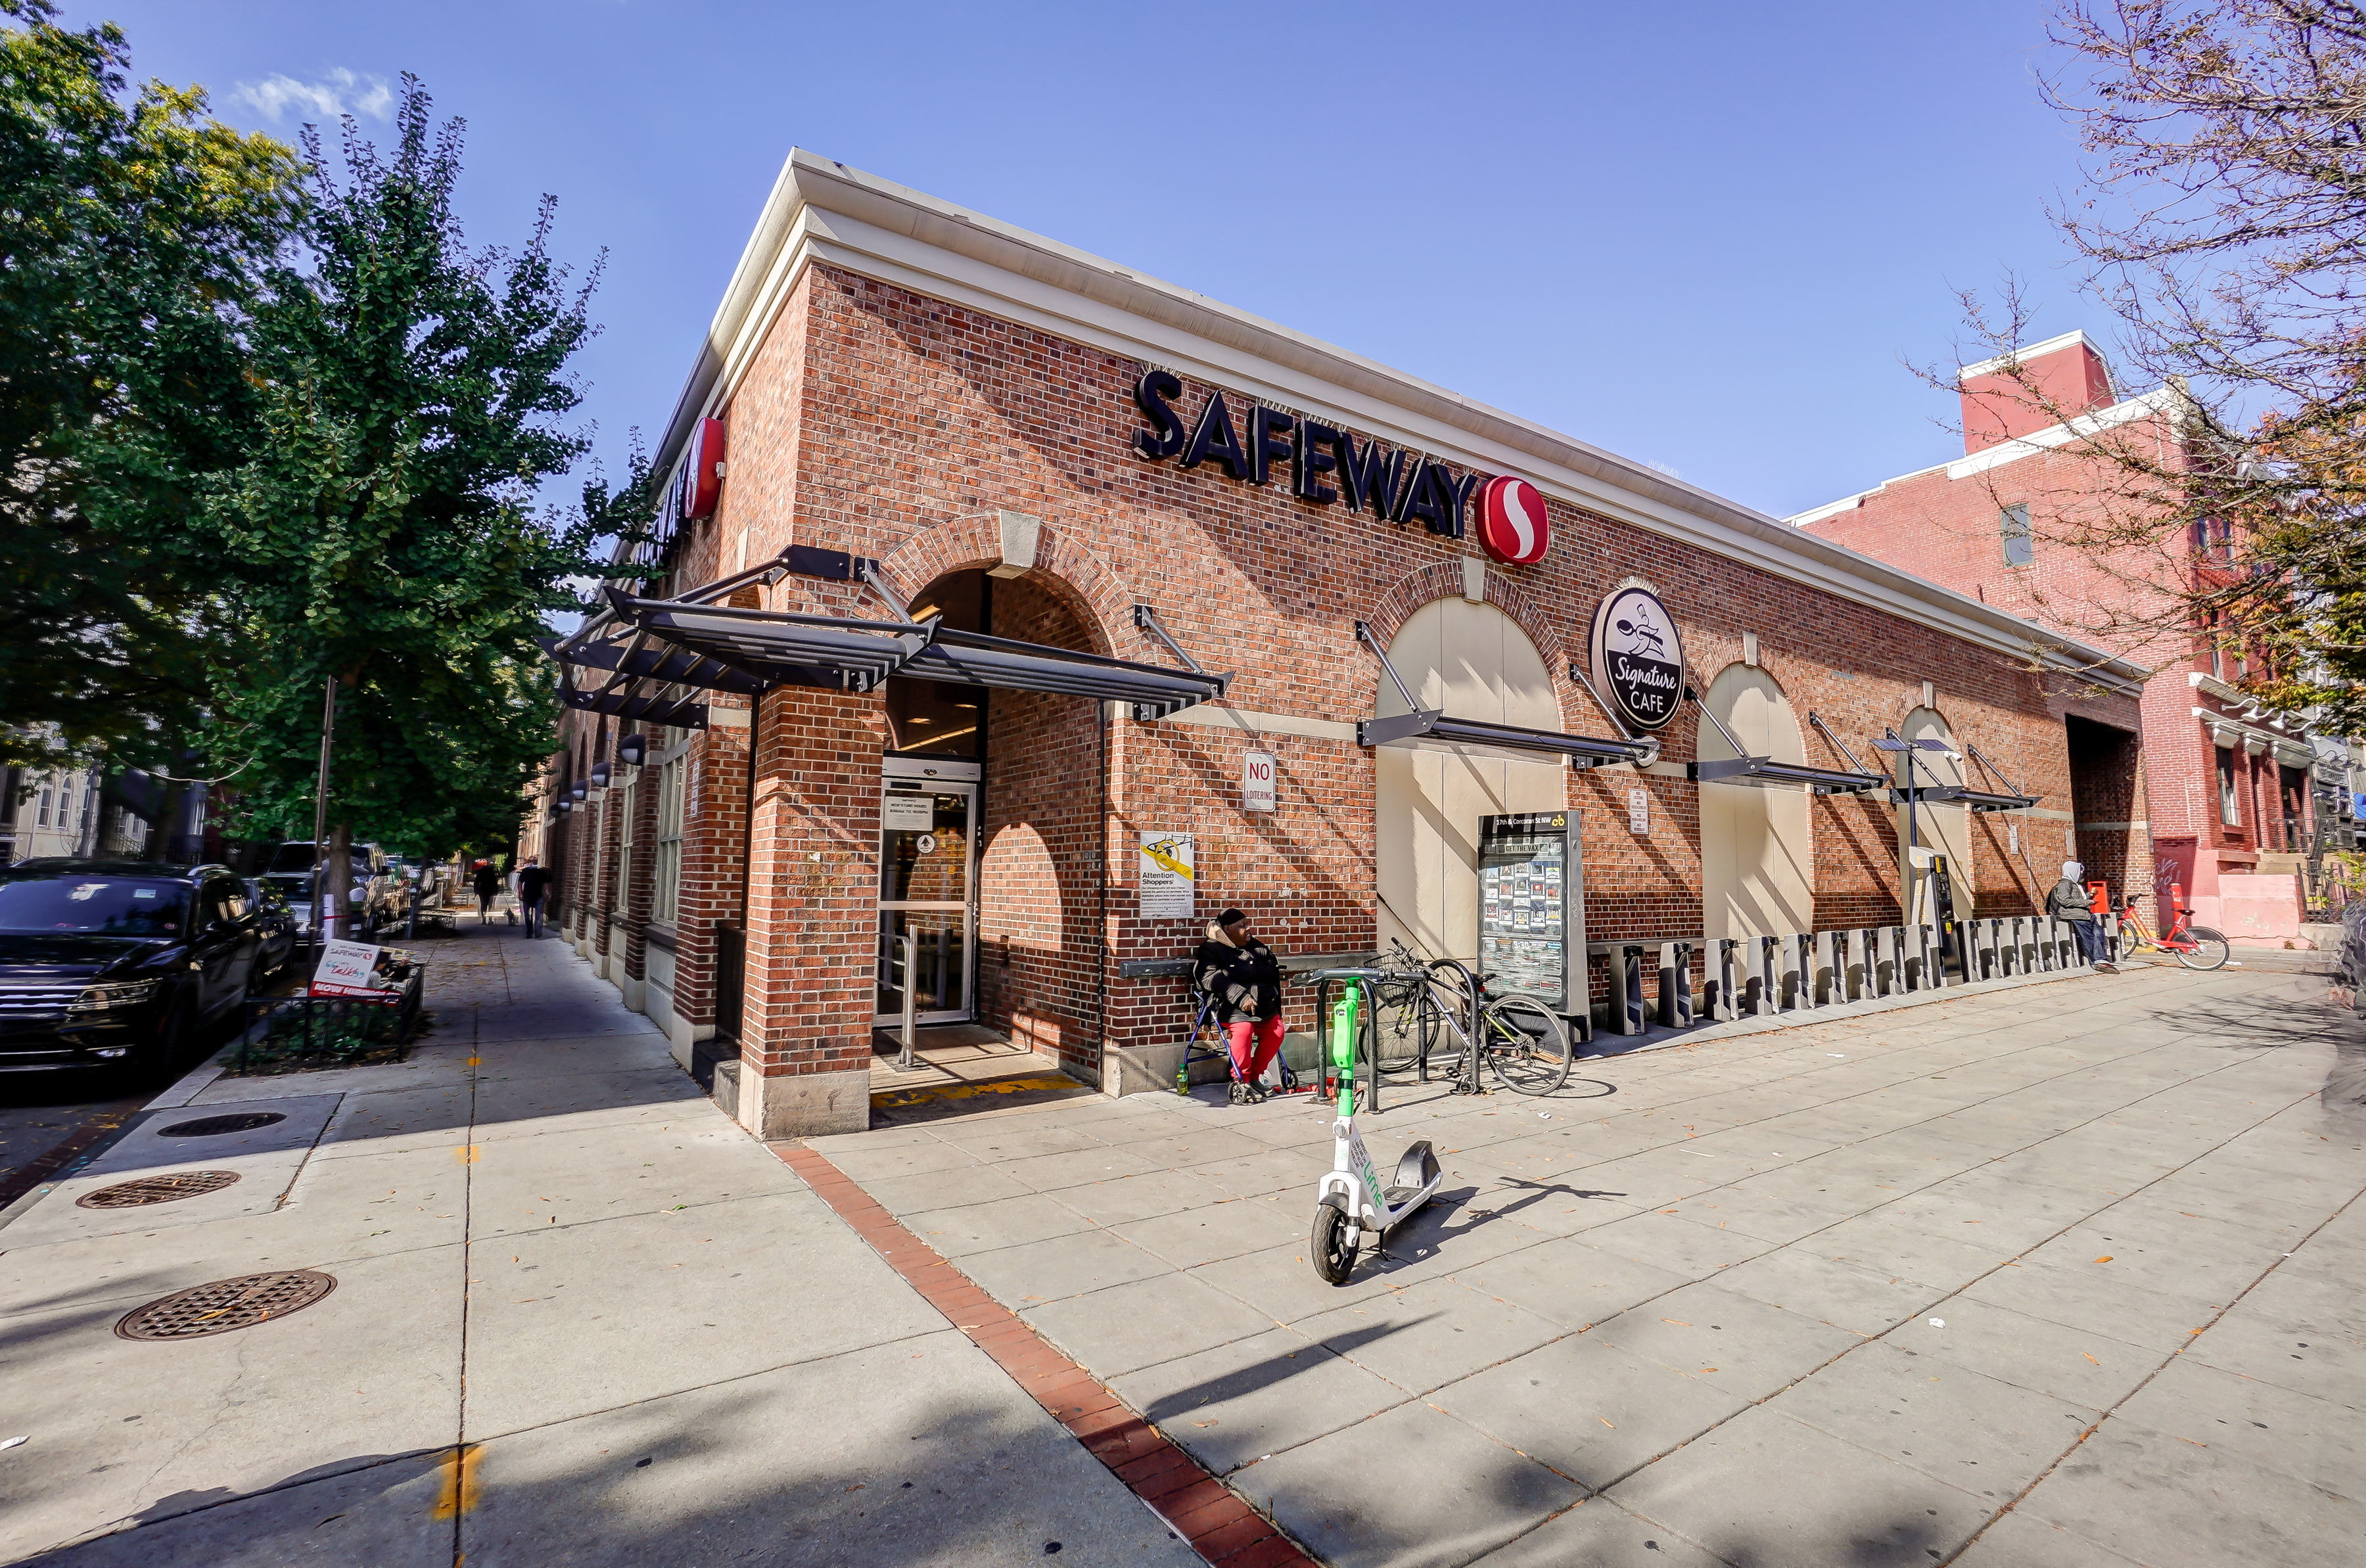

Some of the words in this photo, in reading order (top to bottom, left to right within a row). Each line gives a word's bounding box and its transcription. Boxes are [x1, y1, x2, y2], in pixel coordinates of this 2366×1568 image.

[1132, 369, 1477, 540] SAFEWAY
[1615, 657, 1677, 689] Signature
[1630, 691, 1663, 713] CAFE
[1249, 762, 1270, 781] NO
[1246, 790, 1272, 800] LOITERING
[330, 948, 363, 957] SAFEWAY
[1513, 940, 1529, 950] 9:30
[313, 983, 343, 993] NOW
[1364, 1161, 1382, 1209] Lime
